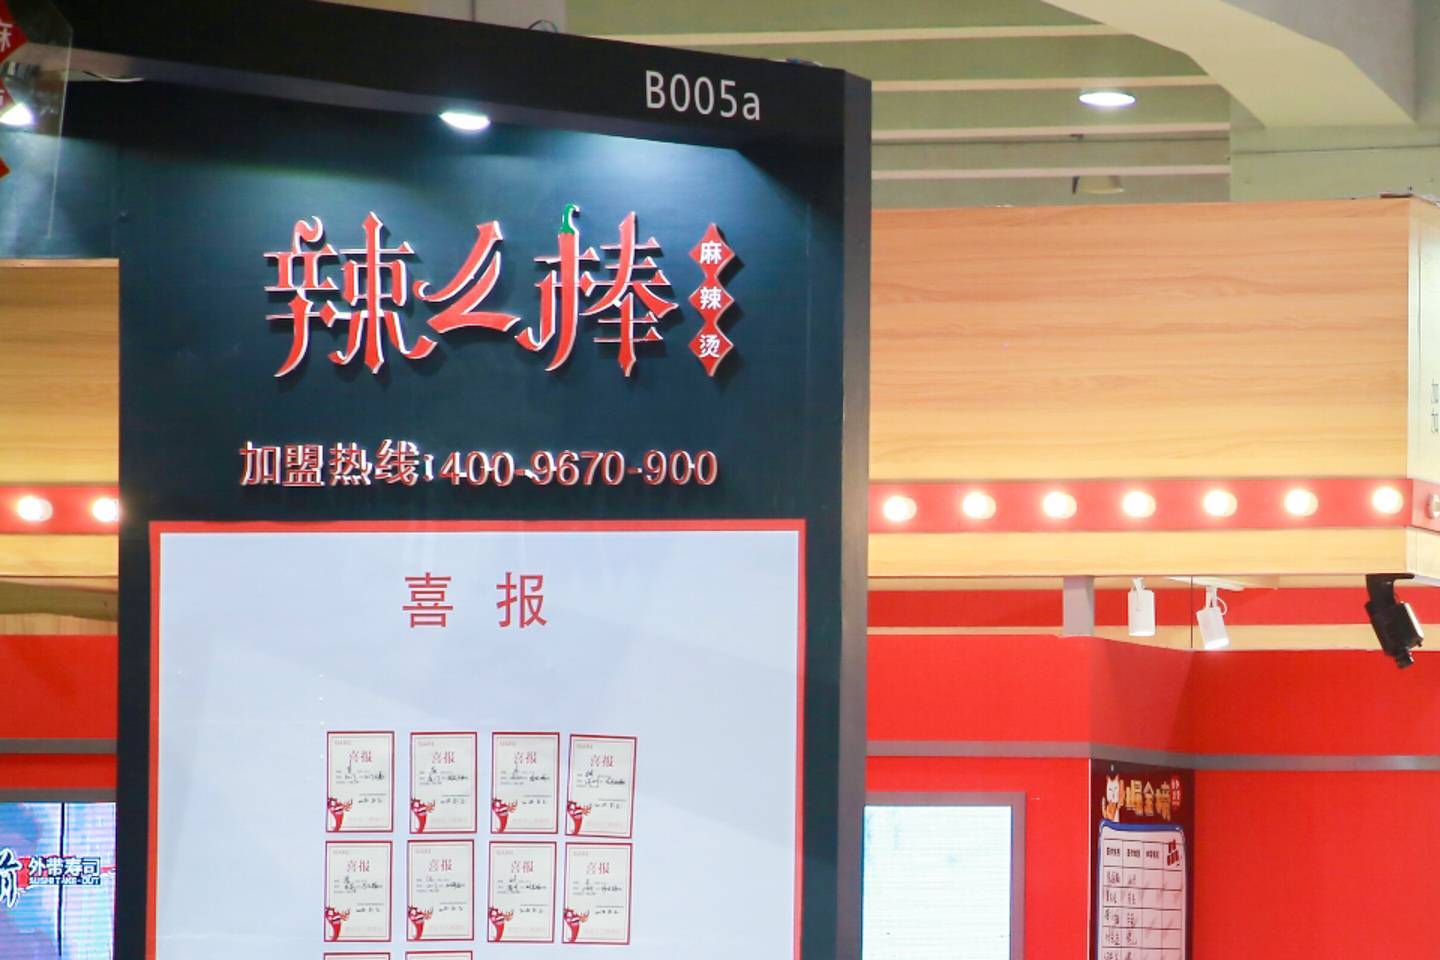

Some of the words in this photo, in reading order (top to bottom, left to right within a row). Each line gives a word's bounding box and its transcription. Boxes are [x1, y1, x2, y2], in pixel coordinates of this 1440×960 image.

[645, 70, 762, 122] B005a
[264, 204, 679, 378] 辣么棒
[697, 239, 724, 360] 麻辣烫
[29, 856, 100, 877] 外带寿司
